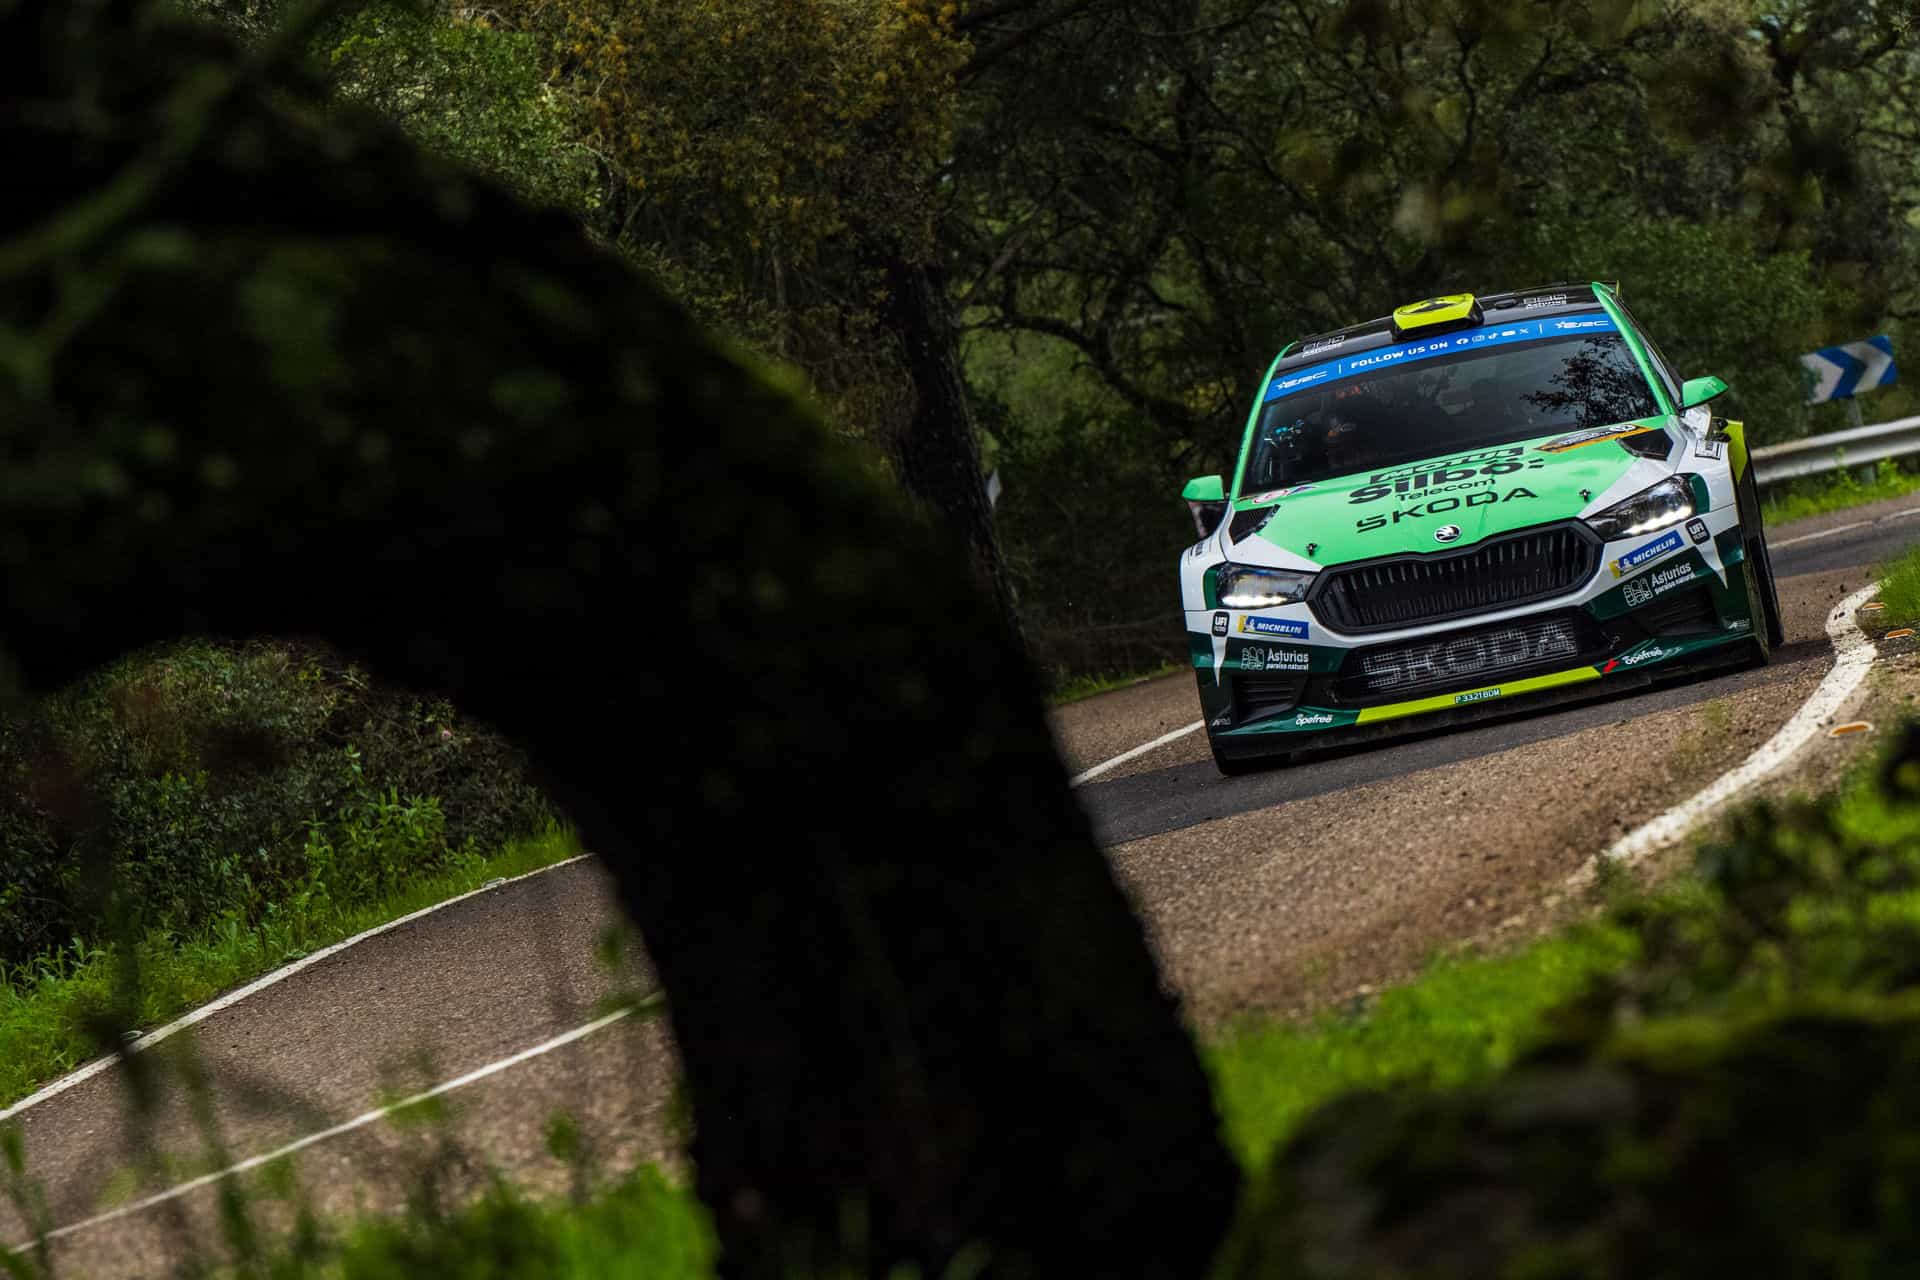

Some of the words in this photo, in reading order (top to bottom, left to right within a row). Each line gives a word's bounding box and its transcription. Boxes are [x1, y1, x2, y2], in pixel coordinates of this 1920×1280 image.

[1351, 350, 1405, 369] FOLLOW
[1407, 346, 1426, 357] US
[1429, 341, 1449, 351] ON
[1374, 447, 1521, 483] MOTUL
[1394, 478, 1496, 502] Telecom
[1688, 522, 1705, 535] UFI
[1632, 536, 1677, 565] MICHELIN
[1651, 562, 1692, 587] Asturias
[1214, 616, 1228, 627] UFI
[1256, 621, 1304, 635] MICHELIN
[1266, 647, 1310, 664] Asturias
